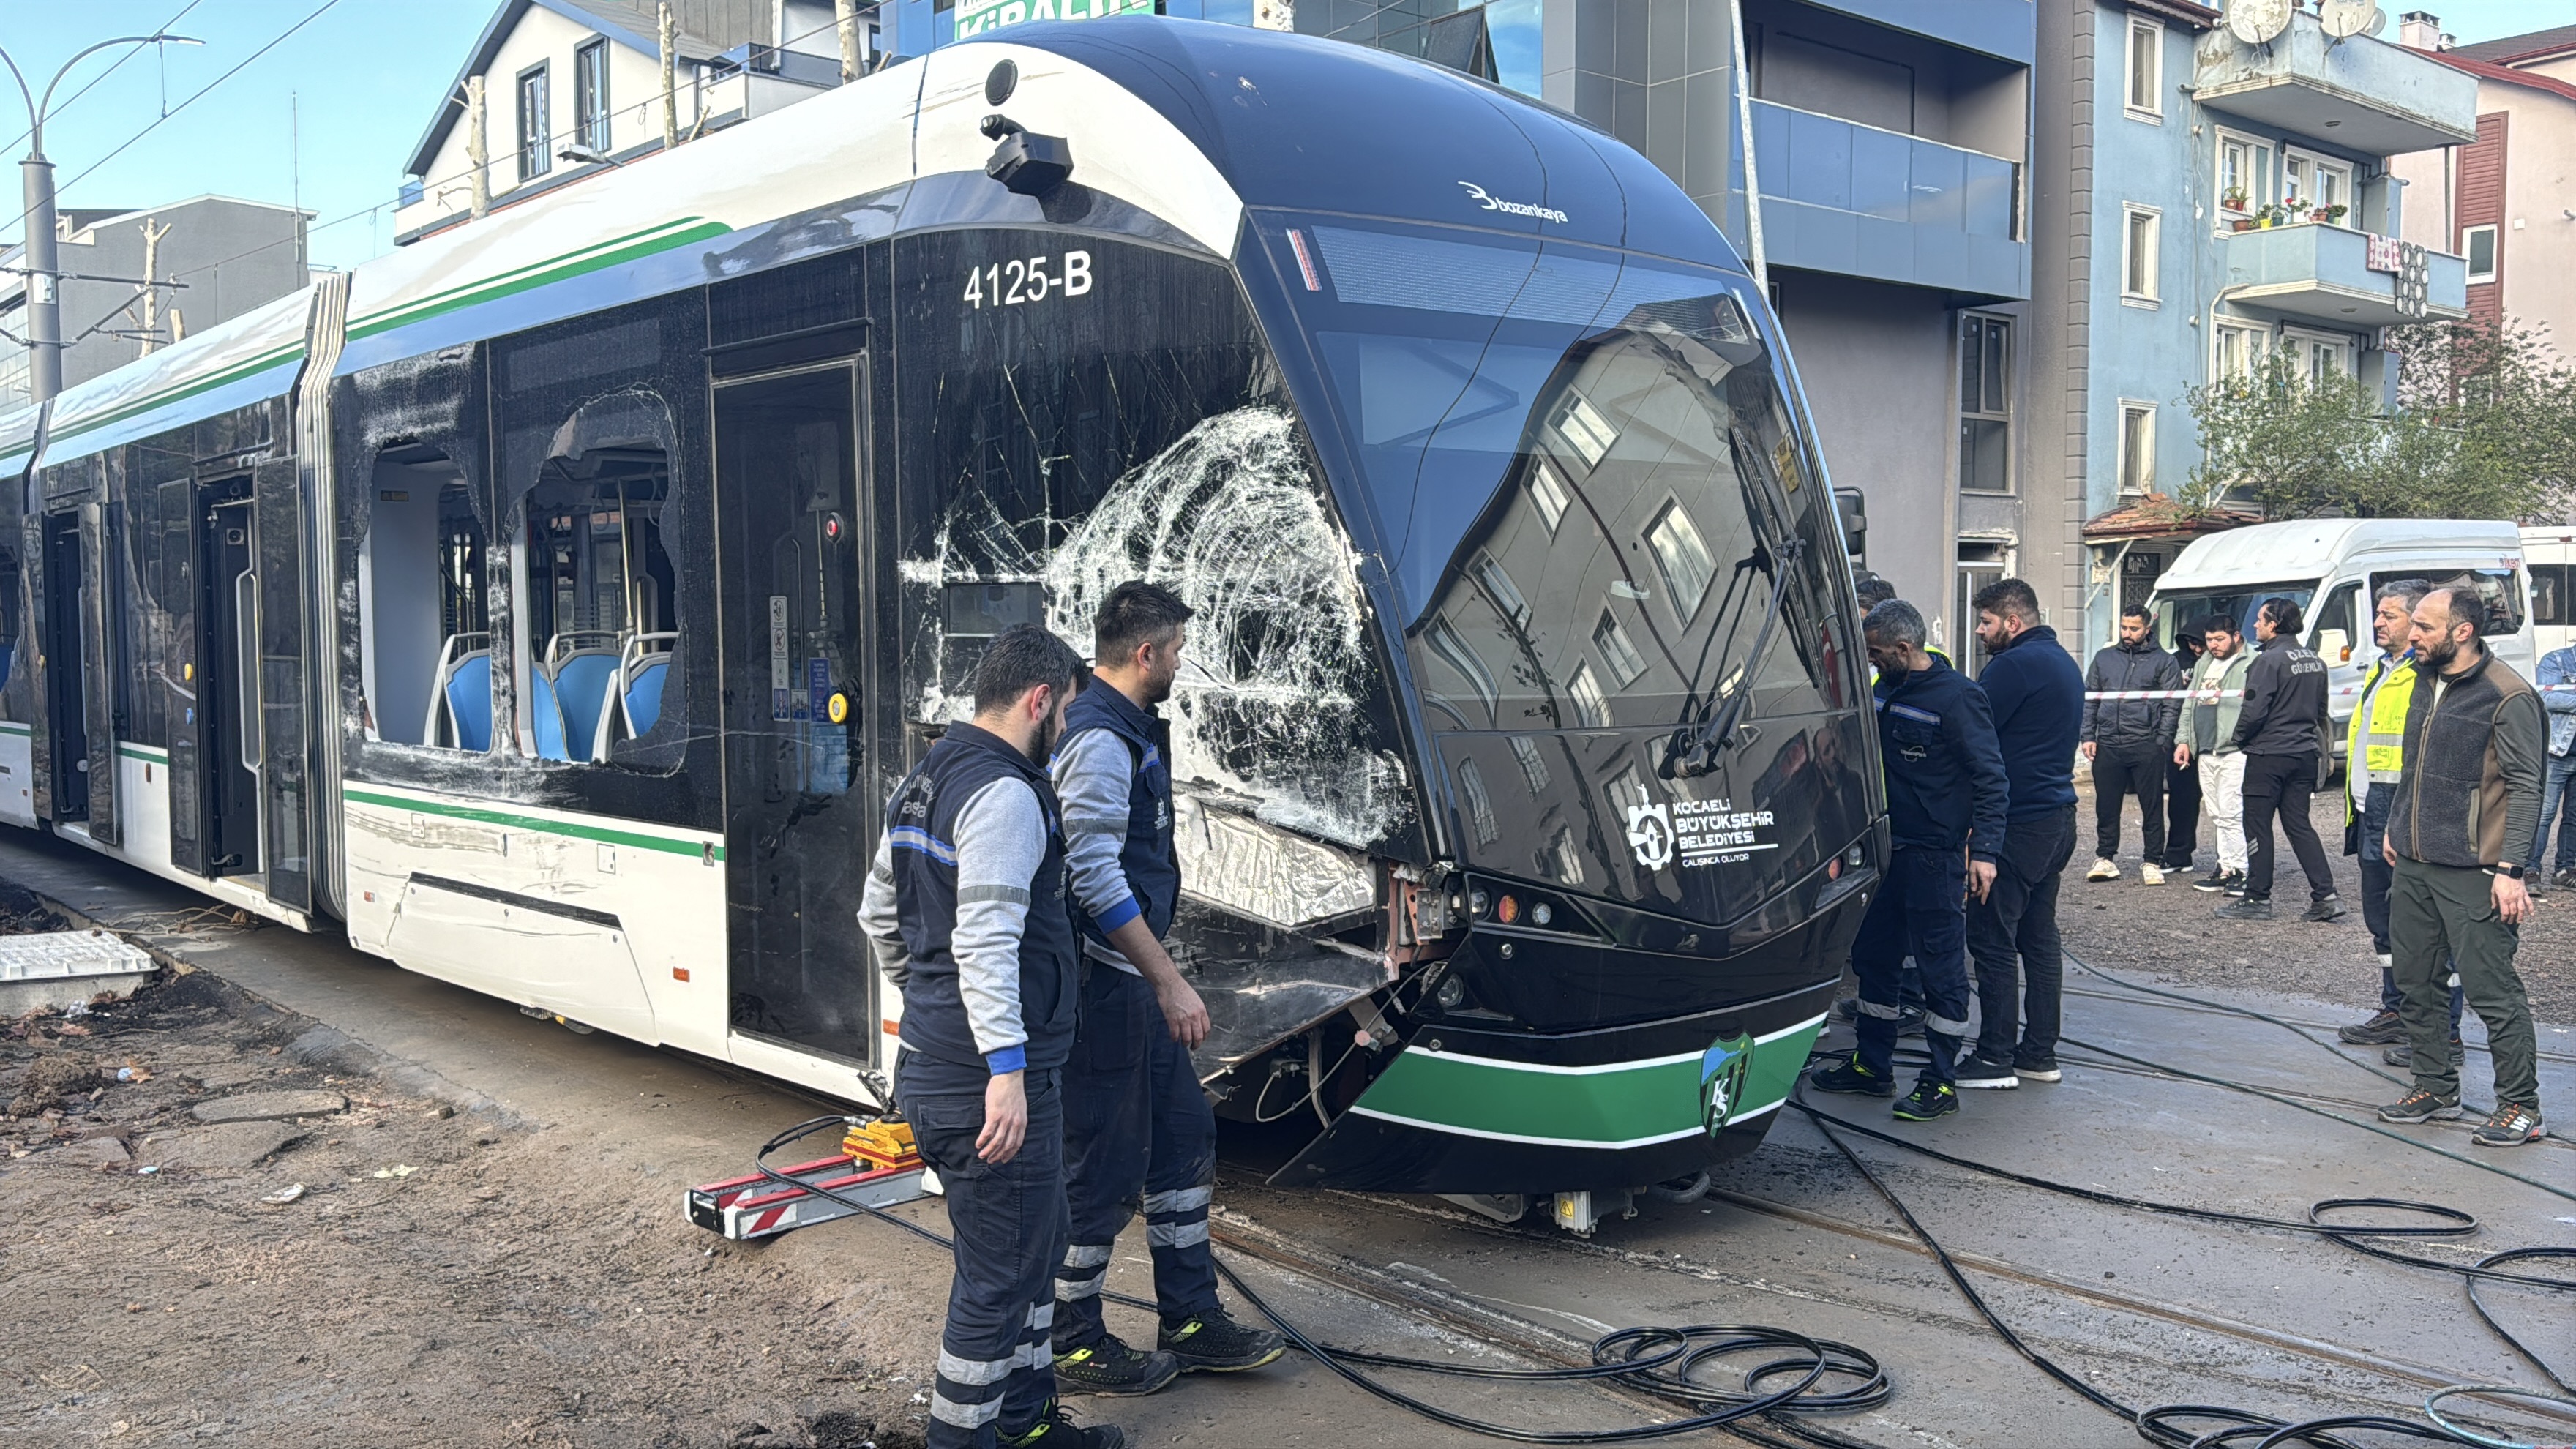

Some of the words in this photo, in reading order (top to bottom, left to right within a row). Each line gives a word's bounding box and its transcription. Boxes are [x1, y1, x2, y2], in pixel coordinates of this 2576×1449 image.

[1494, 197, 1568, 224] bozankaya
[963, 250, 1093, 310] 4125-B
[1672, 798, 1731, 815] KOCAELİ
[1675, 810, 1775, 834] BÜYÜKŞEHİR
[1679, 830, 1756, 850] BELEDİYESİ
[1721, 853, 1750, 864] OLUYOR
